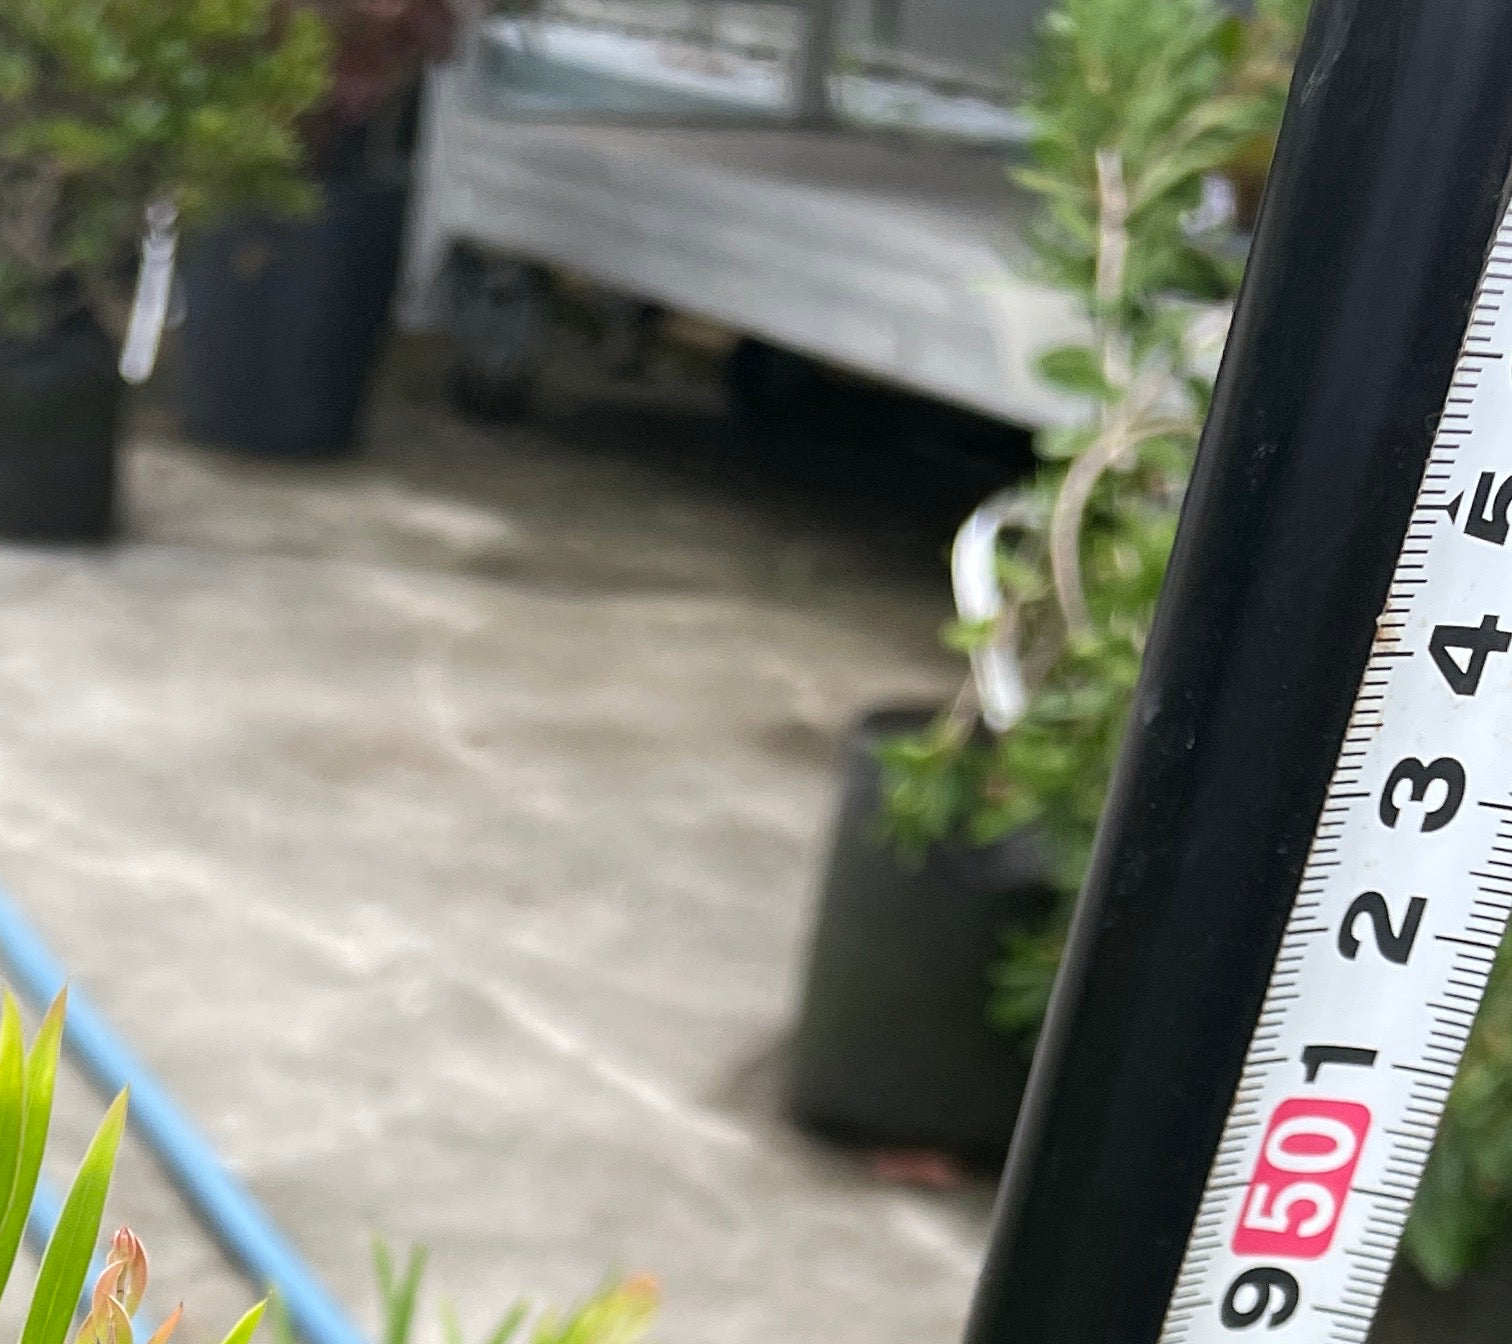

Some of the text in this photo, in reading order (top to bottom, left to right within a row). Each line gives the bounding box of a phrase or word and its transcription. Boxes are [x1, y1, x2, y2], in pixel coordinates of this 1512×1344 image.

[1428, 614, 1512, 698] 4
[1378, 756, 1467, 834] 3
[1337, 890, 1429, 966] 2
[1300, 1044, 1379, 1084] 1
[1243, 1114, 1358, 1238] 50
[1221, 1266, 1301, 1330] 9
